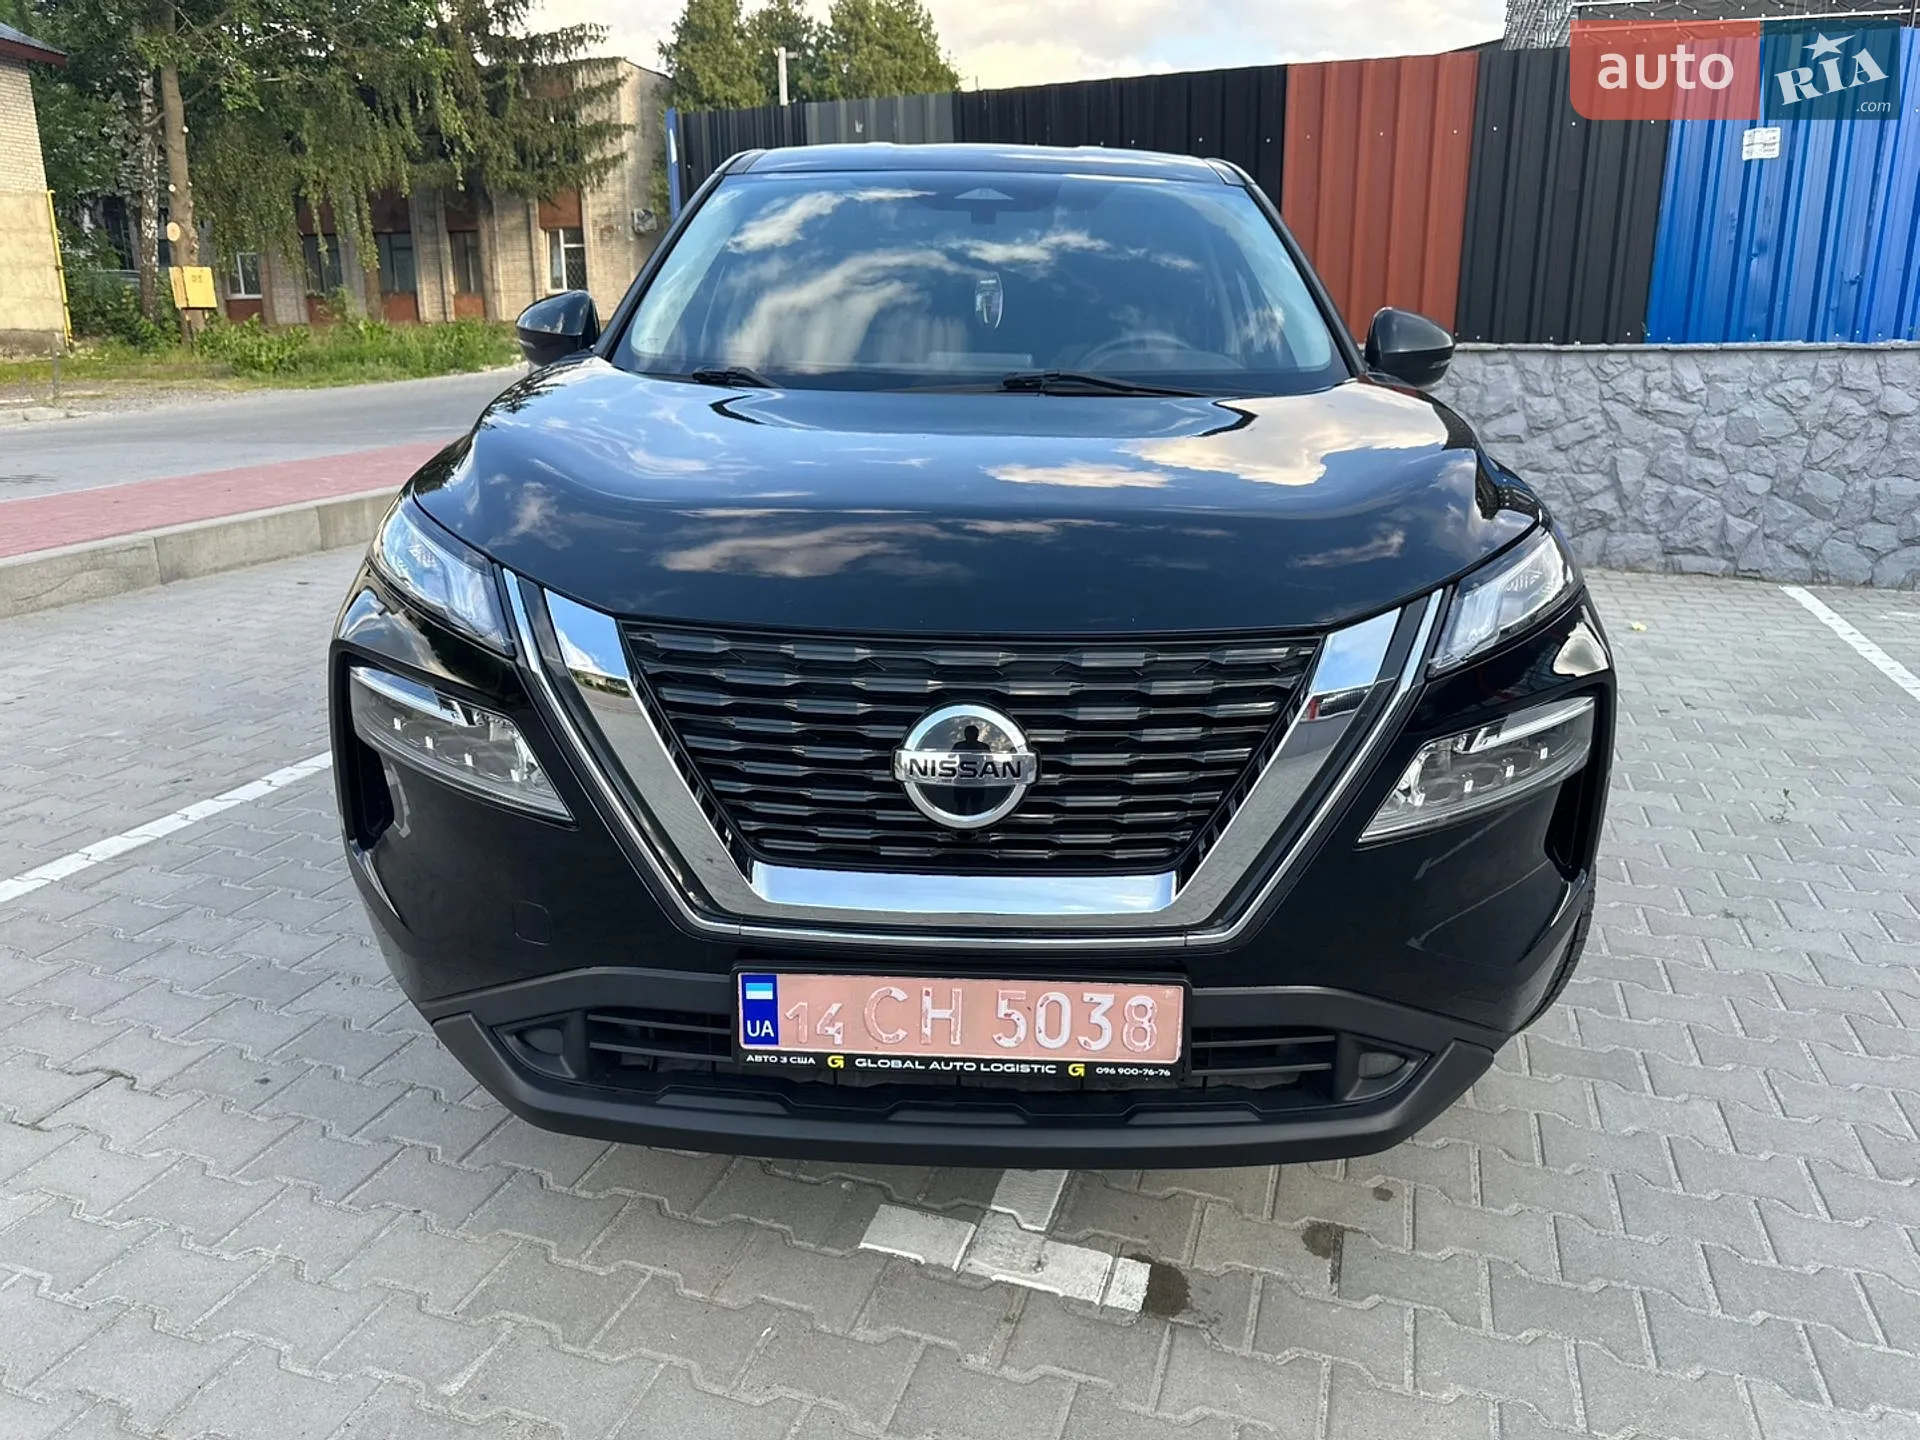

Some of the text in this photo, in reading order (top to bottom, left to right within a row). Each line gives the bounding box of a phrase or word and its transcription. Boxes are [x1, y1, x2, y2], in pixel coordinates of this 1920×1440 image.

[908, 757, 1022, 779] NISSAN
[746, 1019, 775, 1038] UA
[785, 985, 1159, 1053] 14 CH 5038
[746, 1054, 779, 1064] АВТО
[789, 1055, 816, 1065] США
[854, 1058, 1057, 1075] GLOBAL AUTO LOGISTIC
